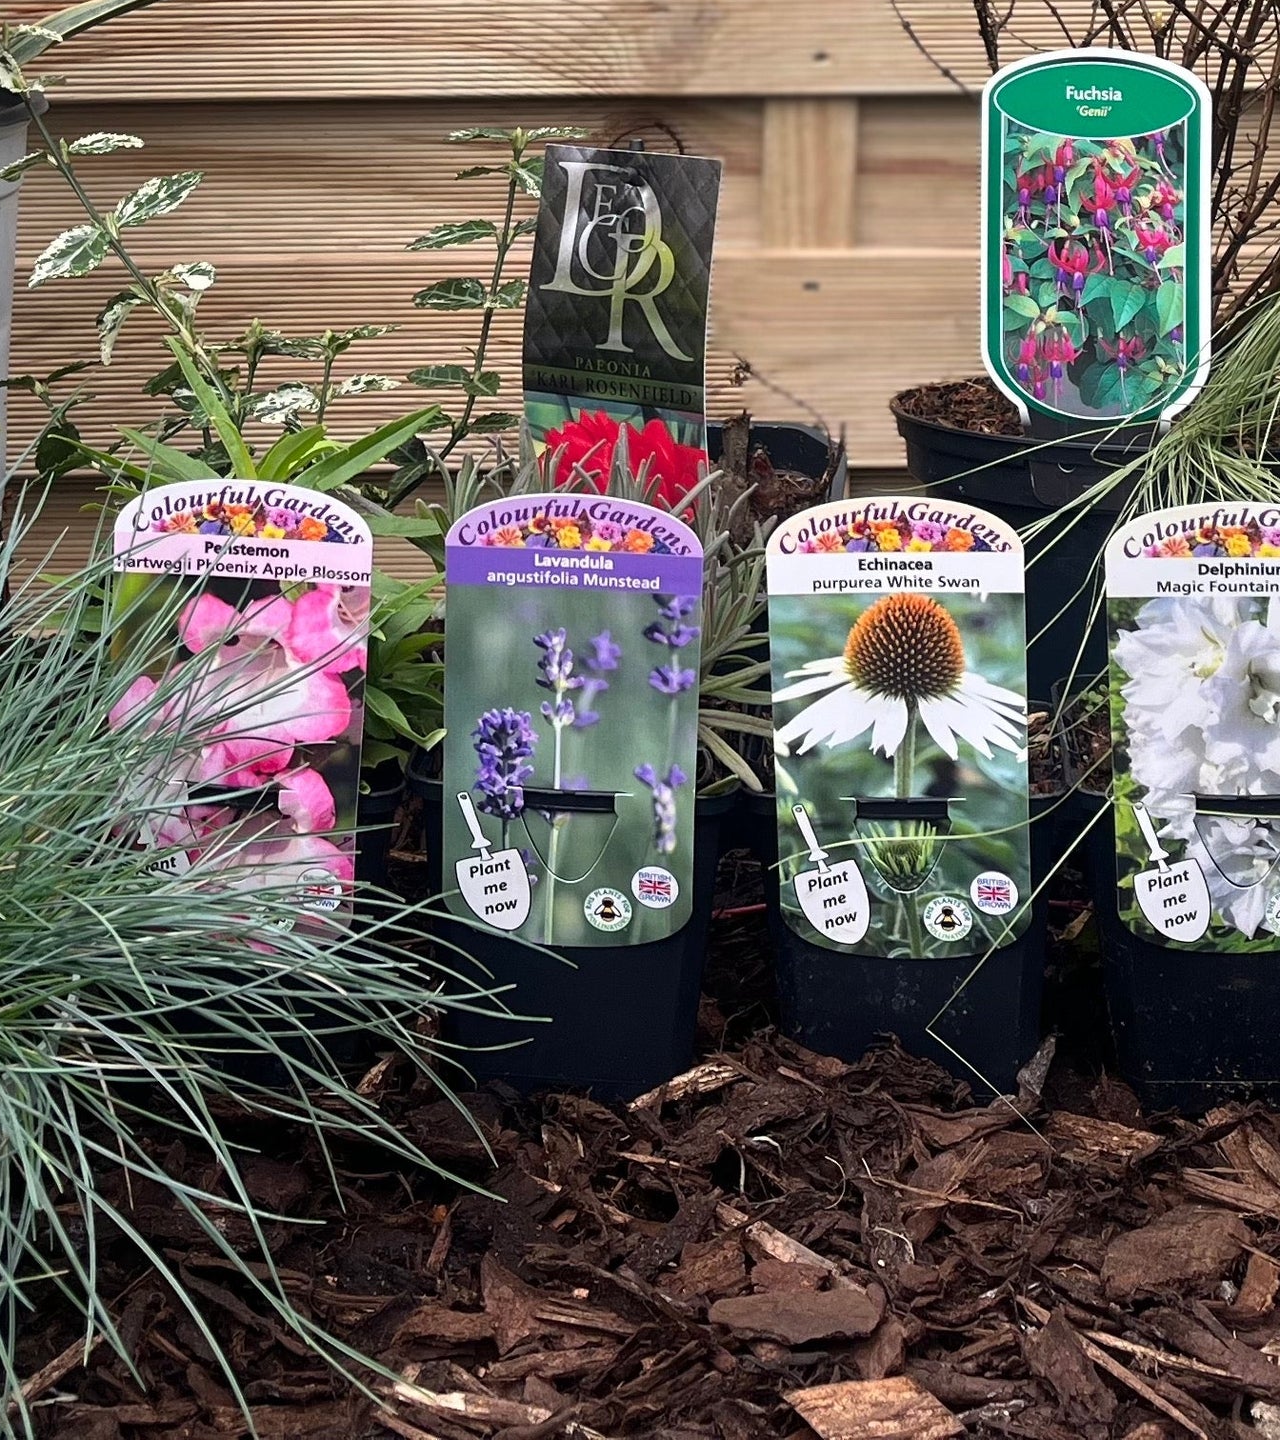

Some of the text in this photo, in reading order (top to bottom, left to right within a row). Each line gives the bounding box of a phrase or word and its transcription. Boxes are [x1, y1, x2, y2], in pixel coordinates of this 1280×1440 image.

[1065, 85, 1123, 101] Fuchsia
[575, 357, 651, 378] PAEONIA
[586, 379, 698, 406] ROSENFIELD'
[132, 485, 365, 545] Colourful Gardens
[458, 499, 692, 556] Colourful Gardens
[779, 501, 1012, 554] Colourful Gardens
[1123, 508, 1249, 558] Colourful
[116, 554, 371, 582] artwegi Phoenix Apple Blossom
[534, 553, 614, 570] Lavandula
[858, 558, 933, 571] Echinacea
[487, 570, 660, 590] angustifolia Munstead
[812, 574, 980, 591] purpurea White Swan
[1156, 580, 1204, 596] Magic
[1209, 580, 1279, 593] Fountain
[470, 859, 511, 878] Plant
[484, 881, 508, 895] me
[808, 870, 849, 892] Plant
[976, 878, 1010, 886] BRITISH
[1147, 869, 1190, 892] Plant
[484, 898, 518, 915] now
[823, 894, 847, 909] me
[977, 900, 1011, 909] GROWN
[1163, 894, 1187, 909] me
[824, 910, 857, 929] now
[1164, 910, 1198, 929] now
